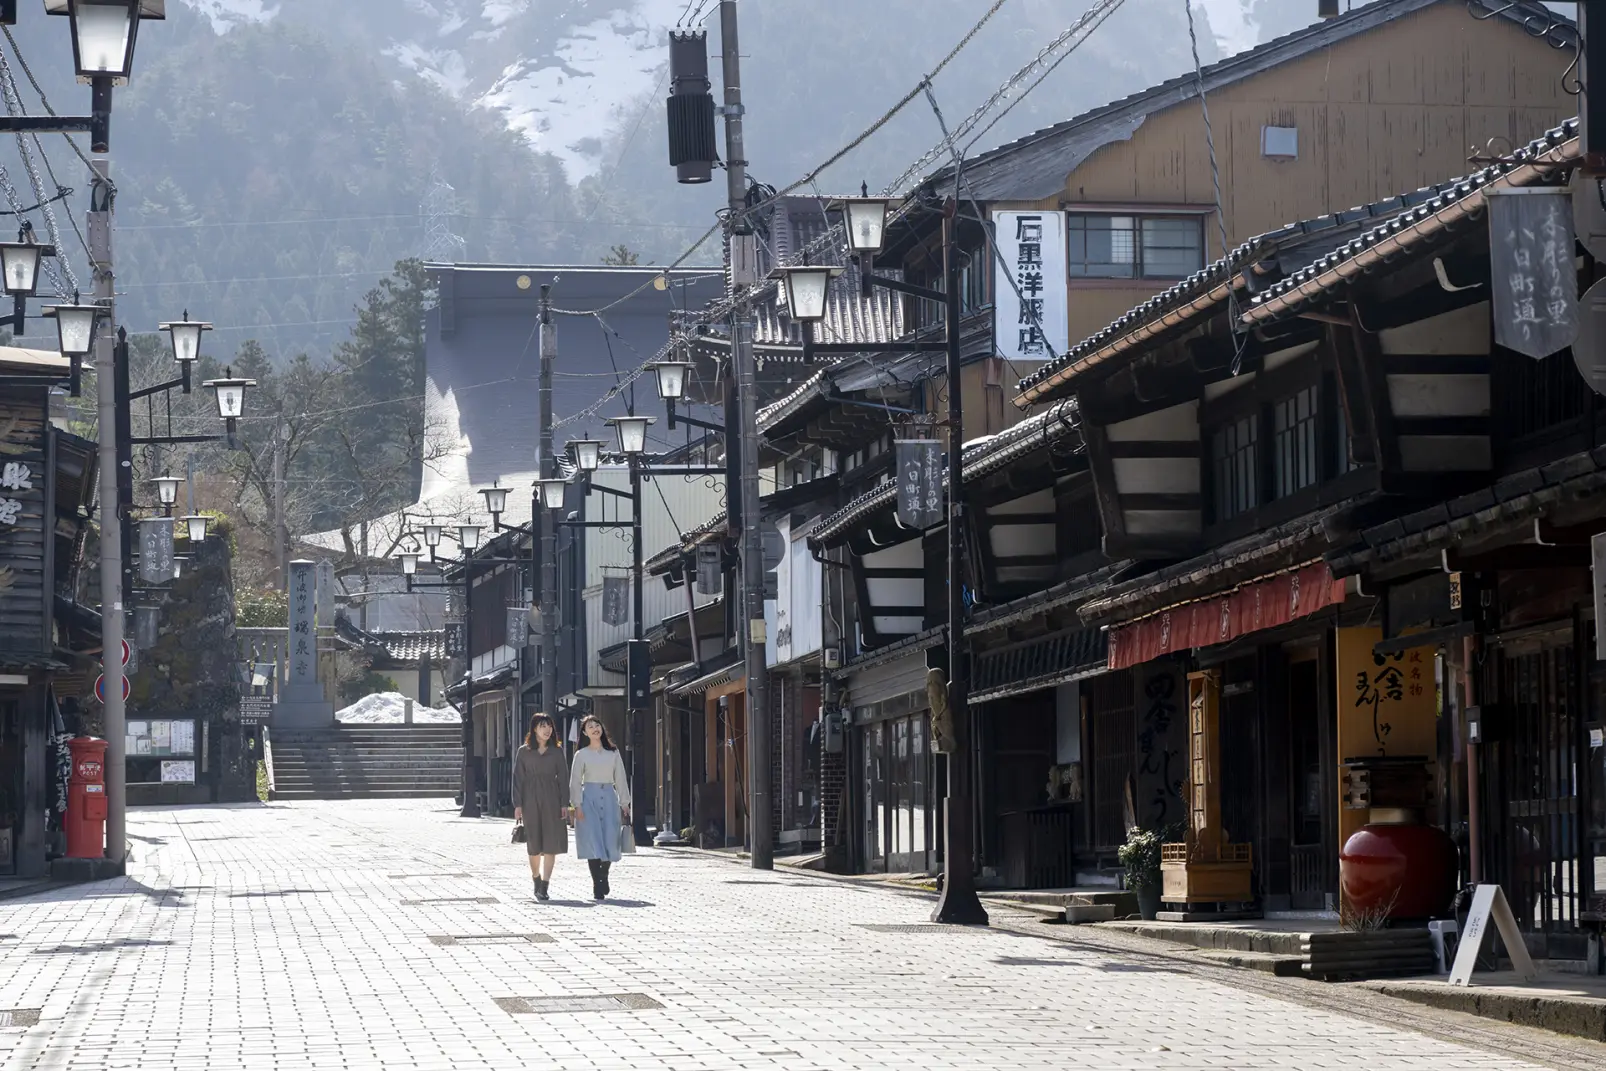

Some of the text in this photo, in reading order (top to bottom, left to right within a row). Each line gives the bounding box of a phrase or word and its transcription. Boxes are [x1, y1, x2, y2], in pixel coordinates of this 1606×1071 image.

[1015, 215, 1044, 355] 石黒洋服店
[1504, 228, 1544, 341] 八日町通り
[1540, 203, 1569, 326] 木彫りの里
[905, 459, 926, 521] 八日町通り
[924, 447, 939, 513] 木彫りの里
